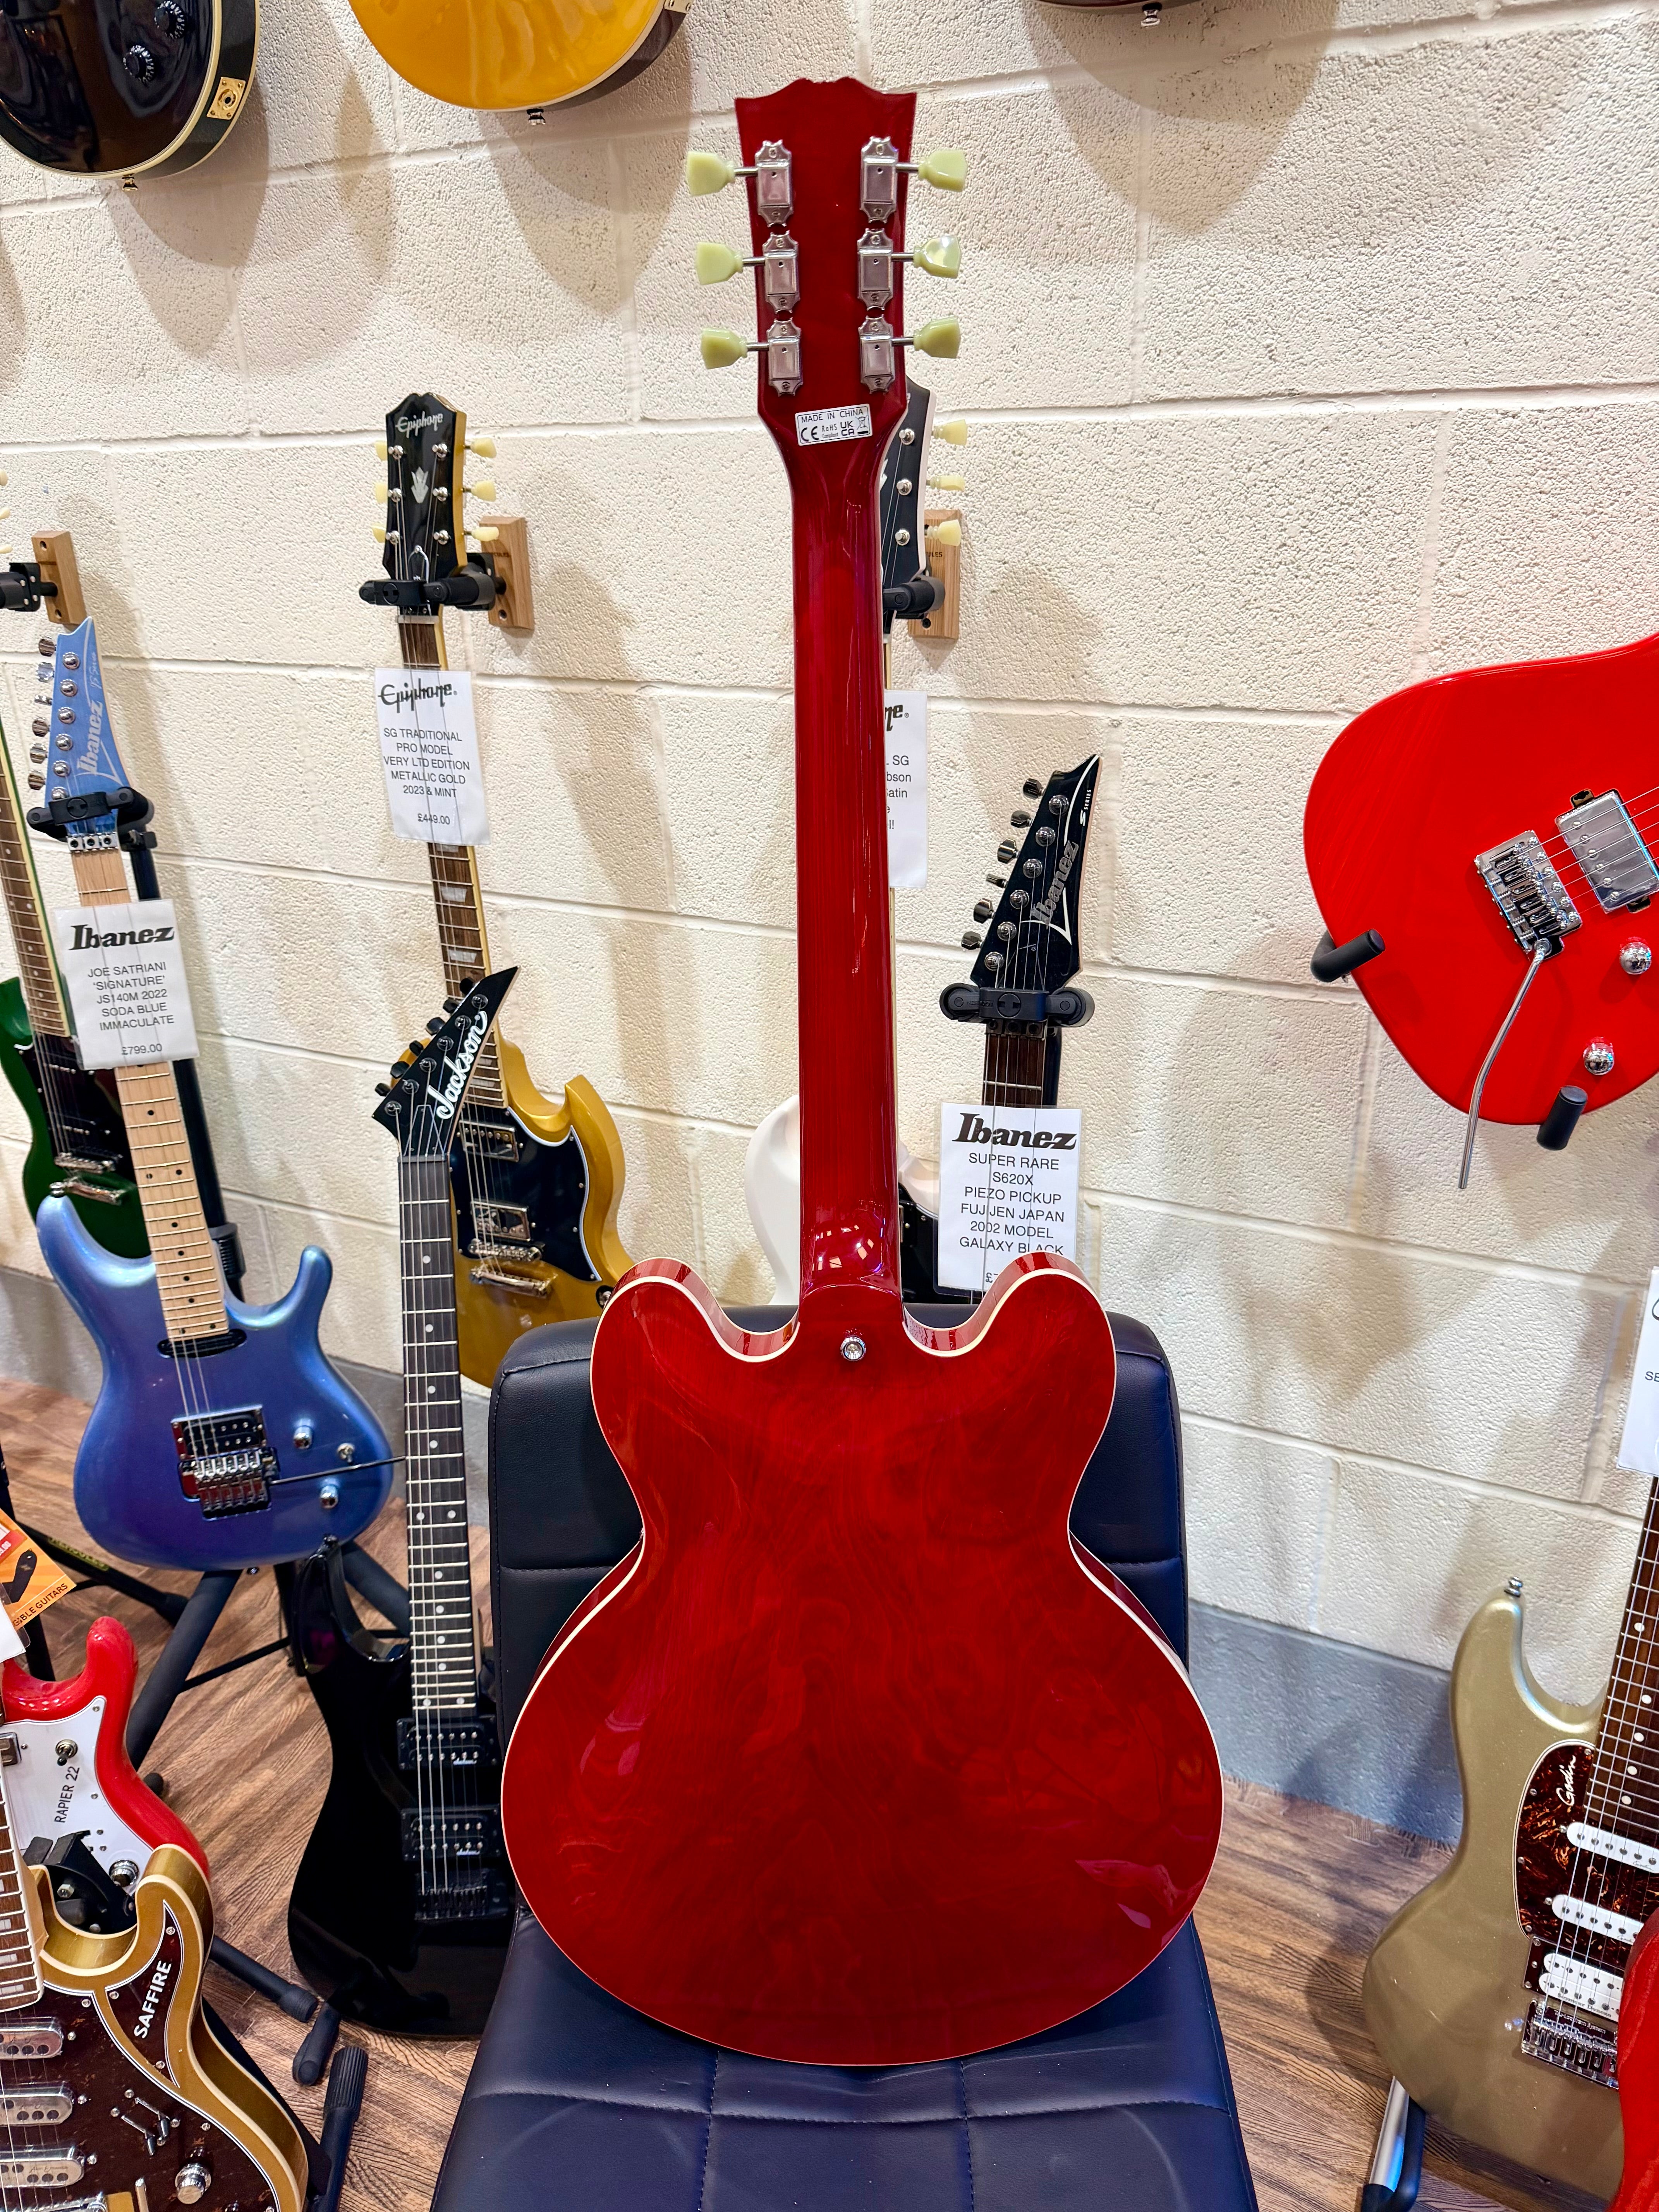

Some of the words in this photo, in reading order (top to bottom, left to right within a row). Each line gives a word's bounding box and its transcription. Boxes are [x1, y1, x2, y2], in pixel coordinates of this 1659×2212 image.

[801, 414, 823, 423] MADE
[840, 409, 864, 417] CHINA
[395, 410, 443, 438] Epiphone
[822, 423, 837, 432] RoHS
[840, 421, 854, 429] UK
[378, 678, 452, 713] Epiphone
[77, 700, 103, 773] Ibanez
[384, 728, 397, 737] SG
[399, 729, 462, 741] TRADITIONAL
[397, 743, 417, 752] PRO
[421, 744, 453, 755] MODEL
[383, 756, 409, 766] VERY
[412, 757, 429, 767] LTD
[432, 759, 470, 770] EDITION
[893, 755, 909, 766] SG
[391, 771, 436, 782] METALLIC
[439, 774, 466, 784] GOLD
[886, 771, 911, 782] bson
[403, 785, 424, 795] 2023
[426, 787, 433, 795] &
[434, 787, 457, 798] MINT
[418, 813, 450, 825] £449.00
[1030, 840, 1079, 929] Ibanez
[69, 924, 175, 950] Ibanez
[88, 967, 110, 978] JOE
[113, 962, 166, 975] SATRIANI
[96, 991, 139, 1004] JS140M
[142, 989, 168, 1000] 2022
[102, 1007, 135, 1017] SODA
[137, 1002, 167, 1013] BLUE
[100, 1015, 175, 1031] IMMACULATE
[121, 1043, 163, 1055] £799.00
[427, 1010, 488, 1120] Jackson
[952, 1113, 1077, 1150] Ibanez
[969, 1152, 1015, 1167] SUPER
[1020, 1157, 1059, 1170] RARE
[993, 1171, 1034, 1185] S620X
[965, 1186, 1005, 1200] PIEZO
[1010, 1192, 1061, 1204] PICKUP
[1019, 1209, 1064, 1222] JAPAN
[970, 1221, 1000, 1233] 2002
[1005, 1225, 1054, 1238] MODEL
[960, 1237, 1013, 1252] GALAXY
[35, 1583, 68, 1609] GUITARS
[1556, 1755, 1576, 1806] Godin
[54, 1785, 74, 1823] RAPIER
[65, 1766, 80, 1781] 22
[134, 1960, 172, 2039] SAFFIRE
[1587, 2003, 1611, 2018] Duncan
